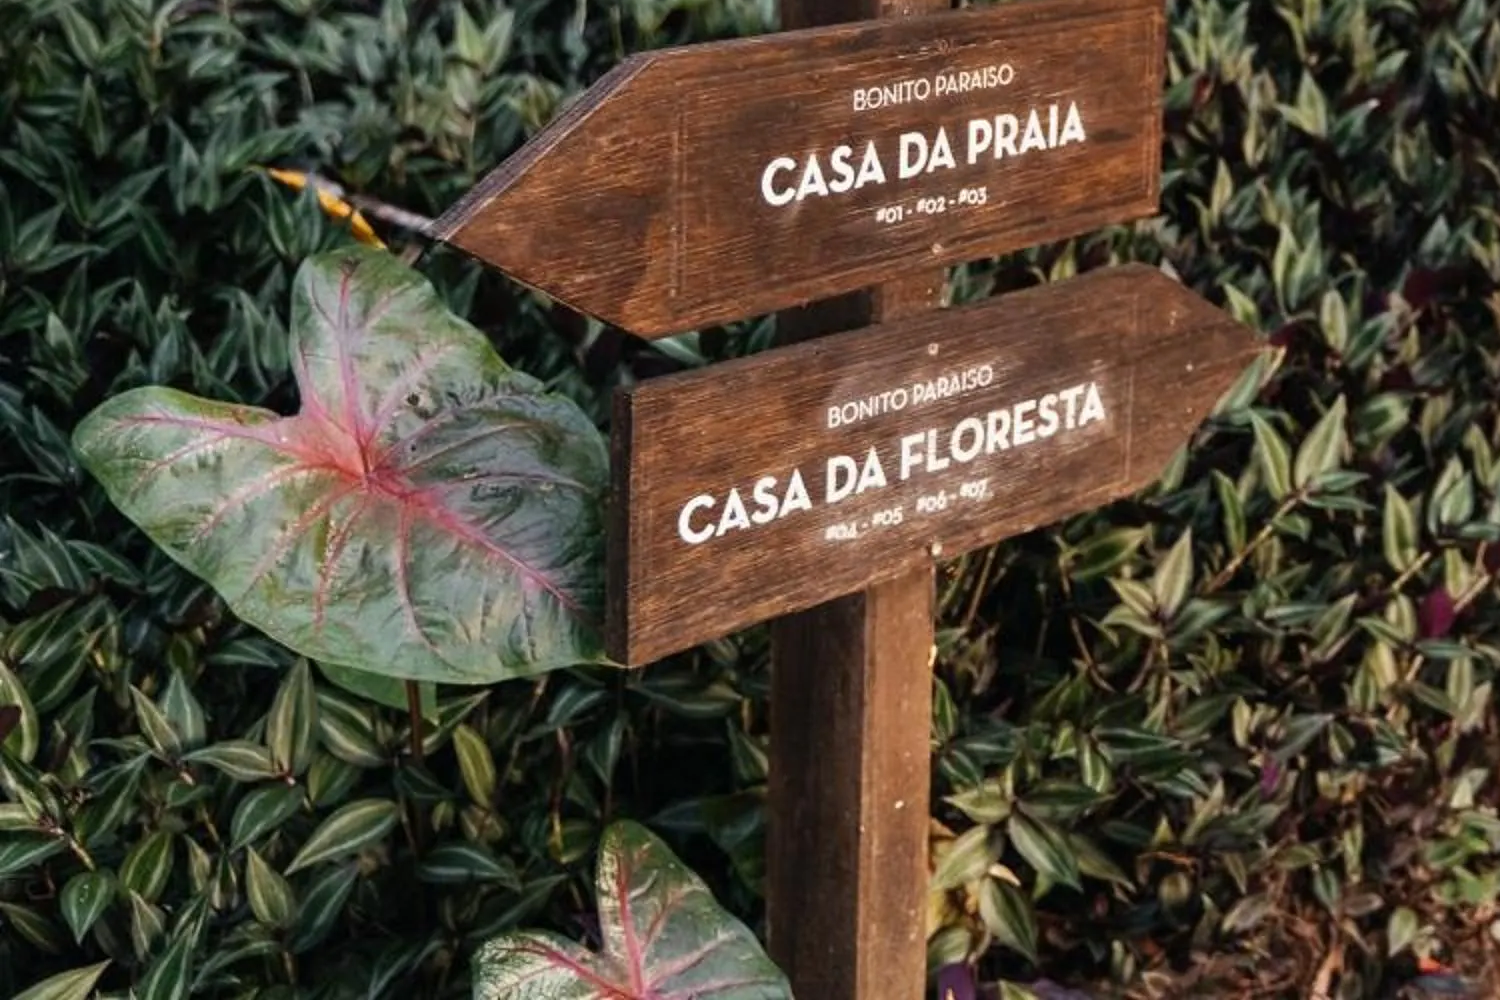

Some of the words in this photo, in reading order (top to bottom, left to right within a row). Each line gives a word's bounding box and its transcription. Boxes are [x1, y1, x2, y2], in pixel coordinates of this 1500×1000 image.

[853, 77, 930, 111] BONITO
[935, 64, 1014, 97] PARAISO
[761, 139, 886, 207] CASA
[899, 125, 956, 180] DA
[967, 100, 1086, 165] PRAIA
[876, 206, 903, 223] #01
[917, 196, 946, 214] #02
[959, 186, 987, 205] #03
[827, 389, 907, 429] BONITO
[912, 365, 993, 406] PARAISO
[678, 468, 812, 544] CASA
[826, 446, 887, 504] DA
[900, 382, 1106, 481] FLORESTA
